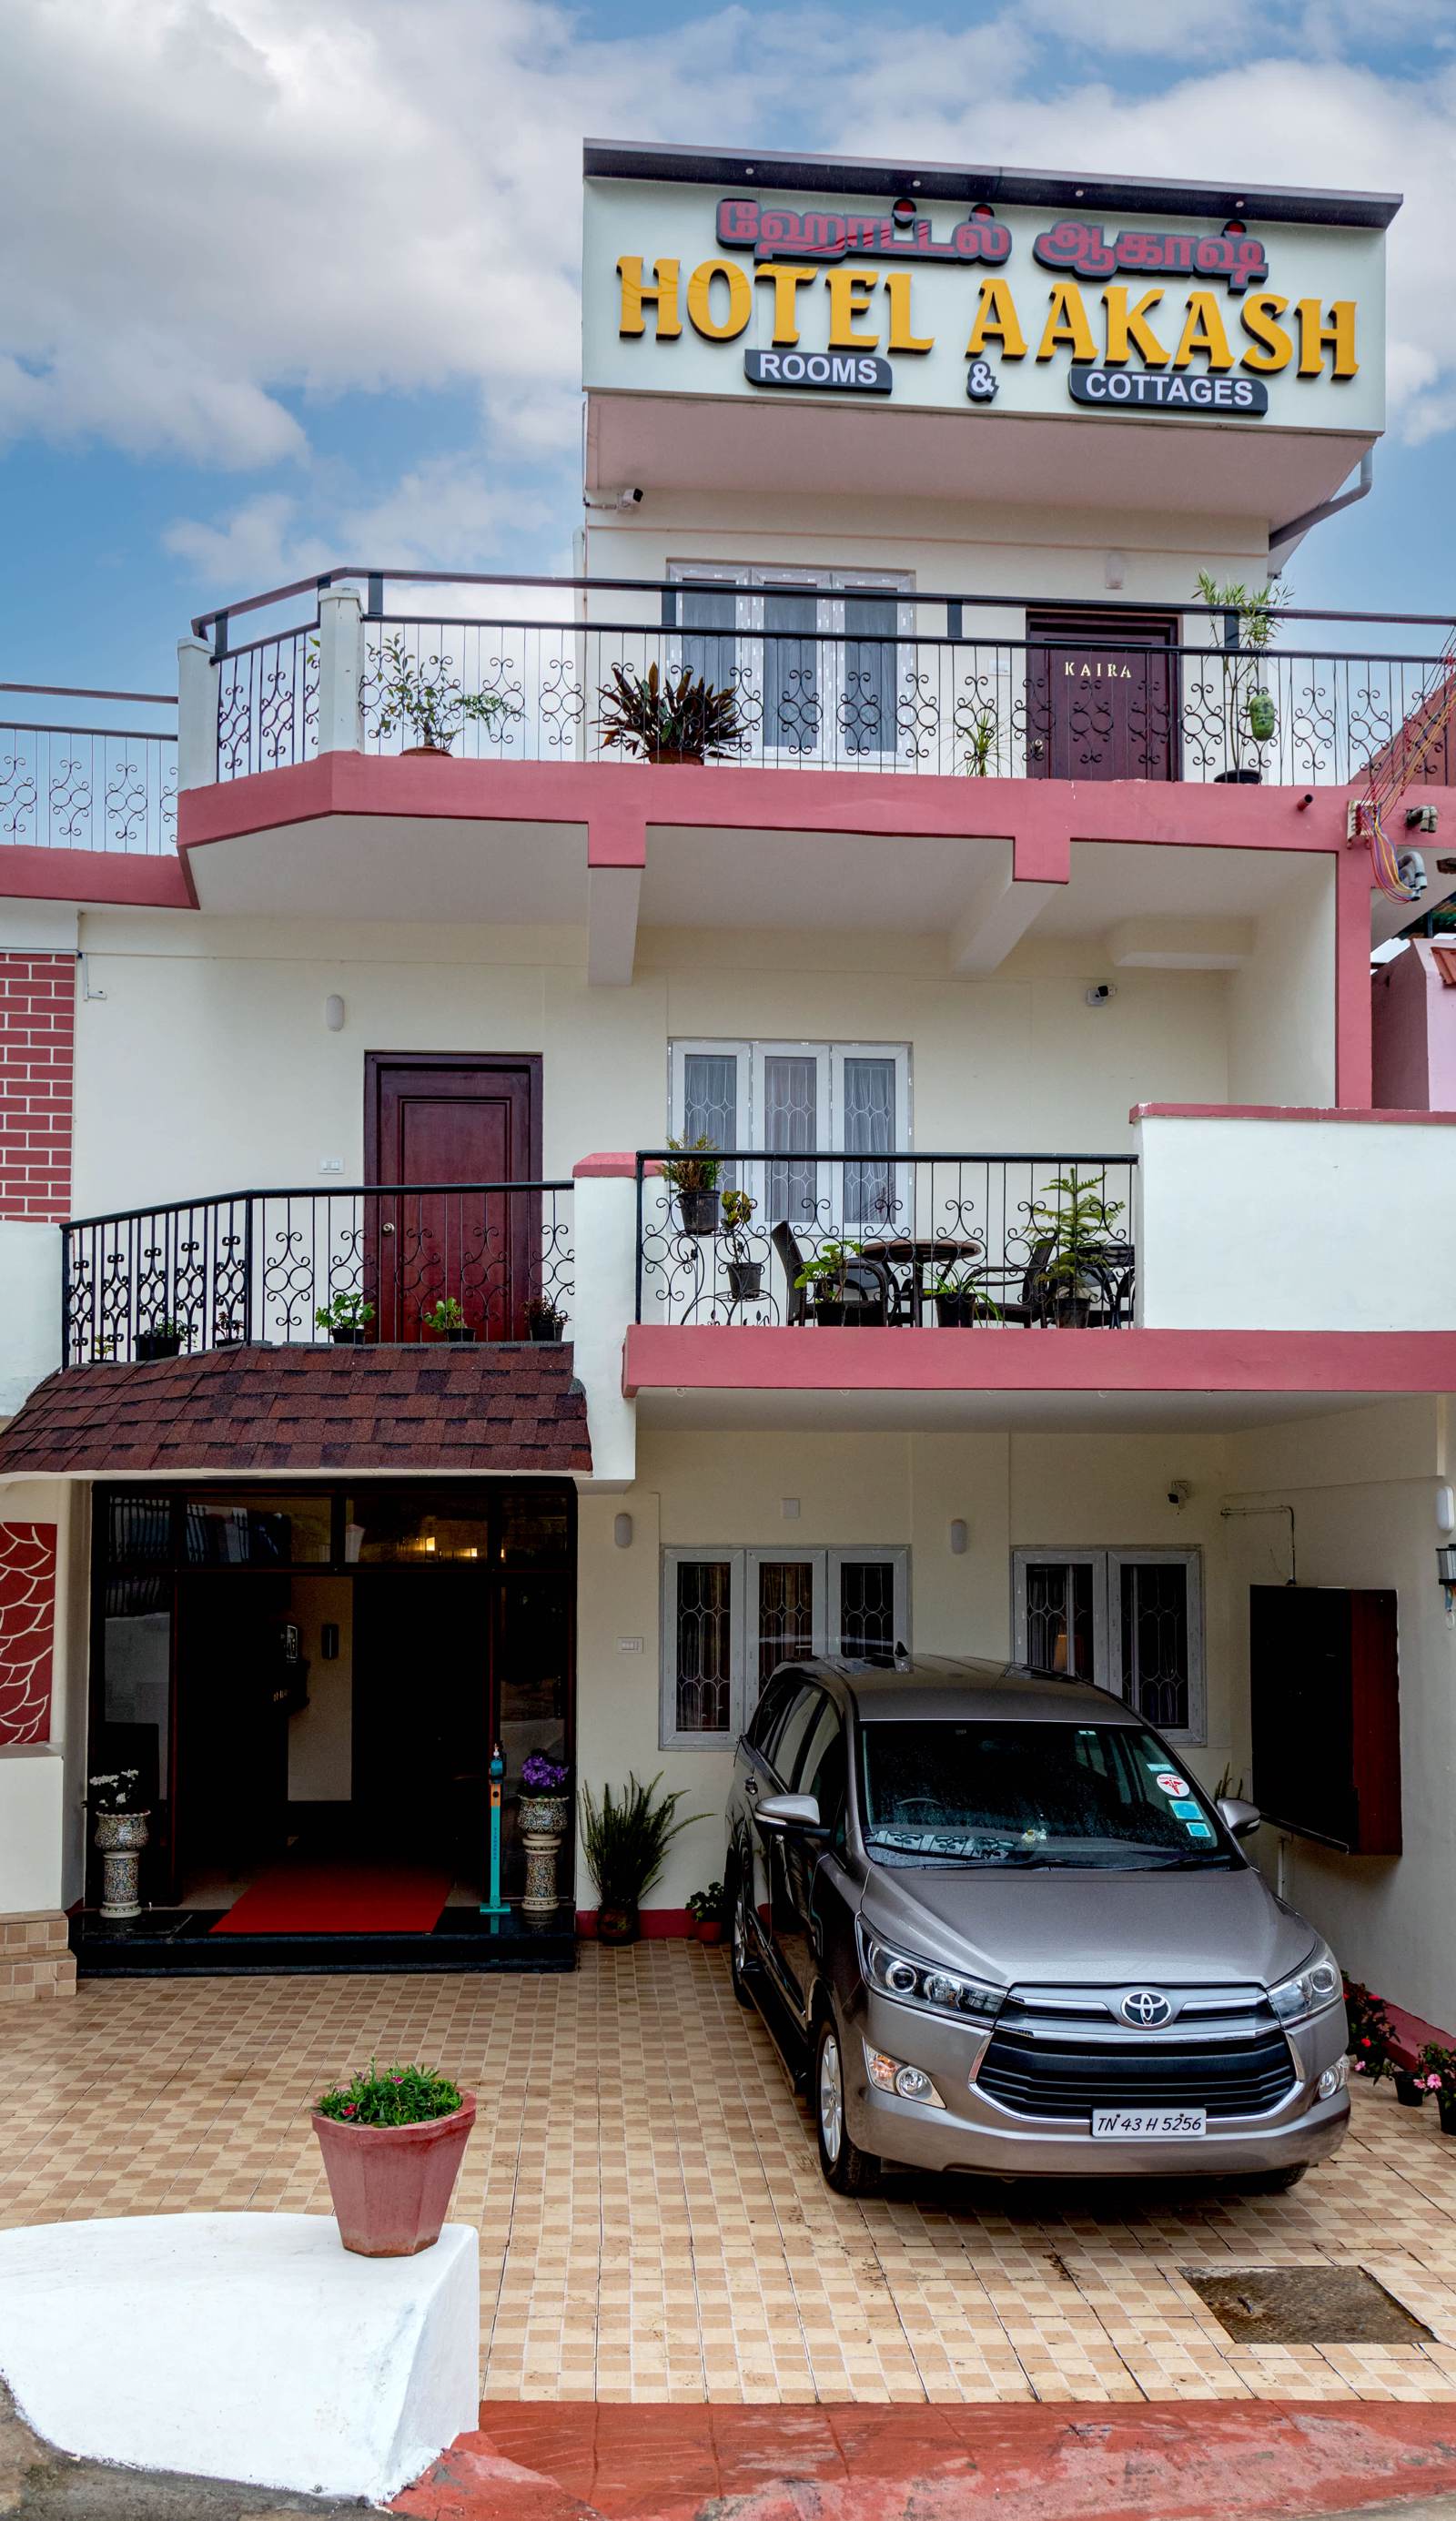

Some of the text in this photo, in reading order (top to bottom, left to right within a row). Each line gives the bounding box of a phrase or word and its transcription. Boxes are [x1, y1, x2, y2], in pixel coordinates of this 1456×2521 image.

[1037, 221, 1269, 285] ஆகாஷ்
[617, 256, 1360, 379] HOTEL AAKASH
[759, 353, 1254, 406] ROOMS & COTTAGES
[1065, 662, 1131, 678] KAIRA
[1097, 2117, 1201, 2131] TN 43 H 5256
